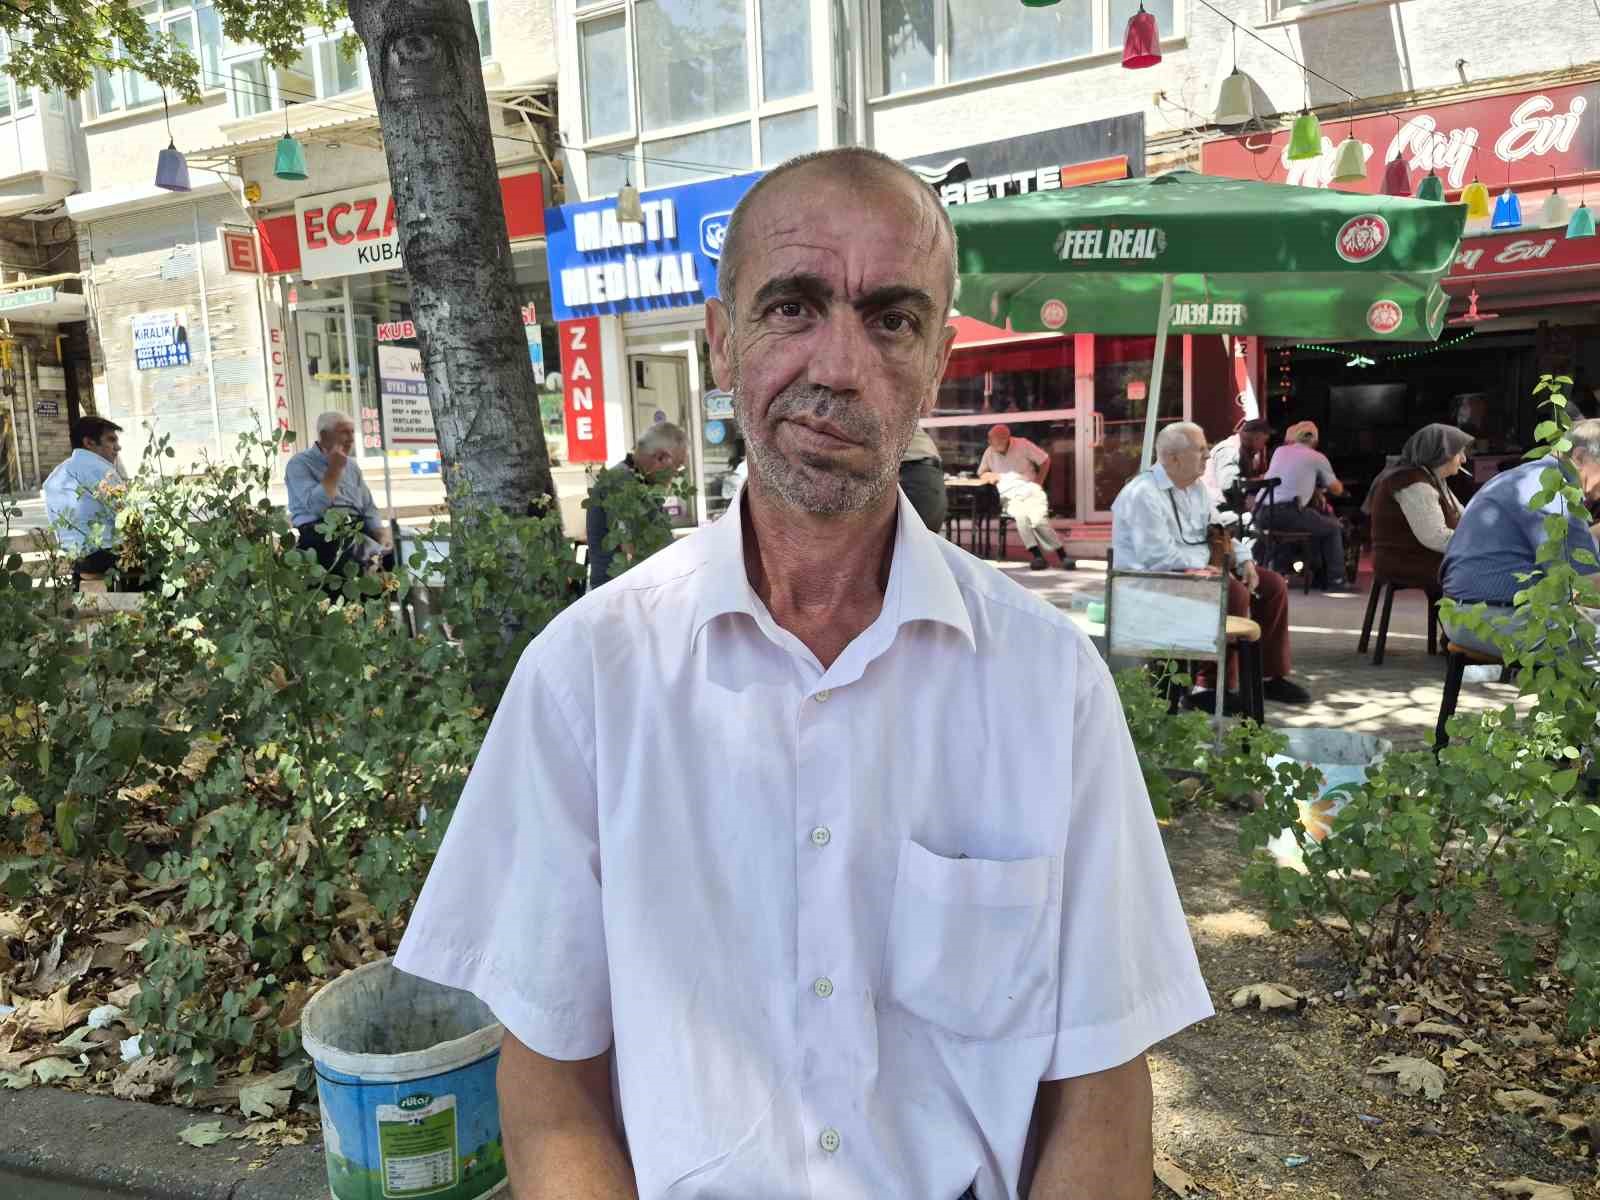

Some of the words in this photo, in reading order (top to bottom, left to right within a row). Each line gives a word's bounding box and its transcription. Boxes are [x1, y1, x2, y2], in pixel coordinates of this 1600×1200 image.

[1495, 96, 1586, 161] Evi
[231, 239, 251, 268] E
[1062, 230, 1104, 259] FEEL
[1106, 228, 1158, 259] REAL
[569, 326, 593, 441] ZANE
